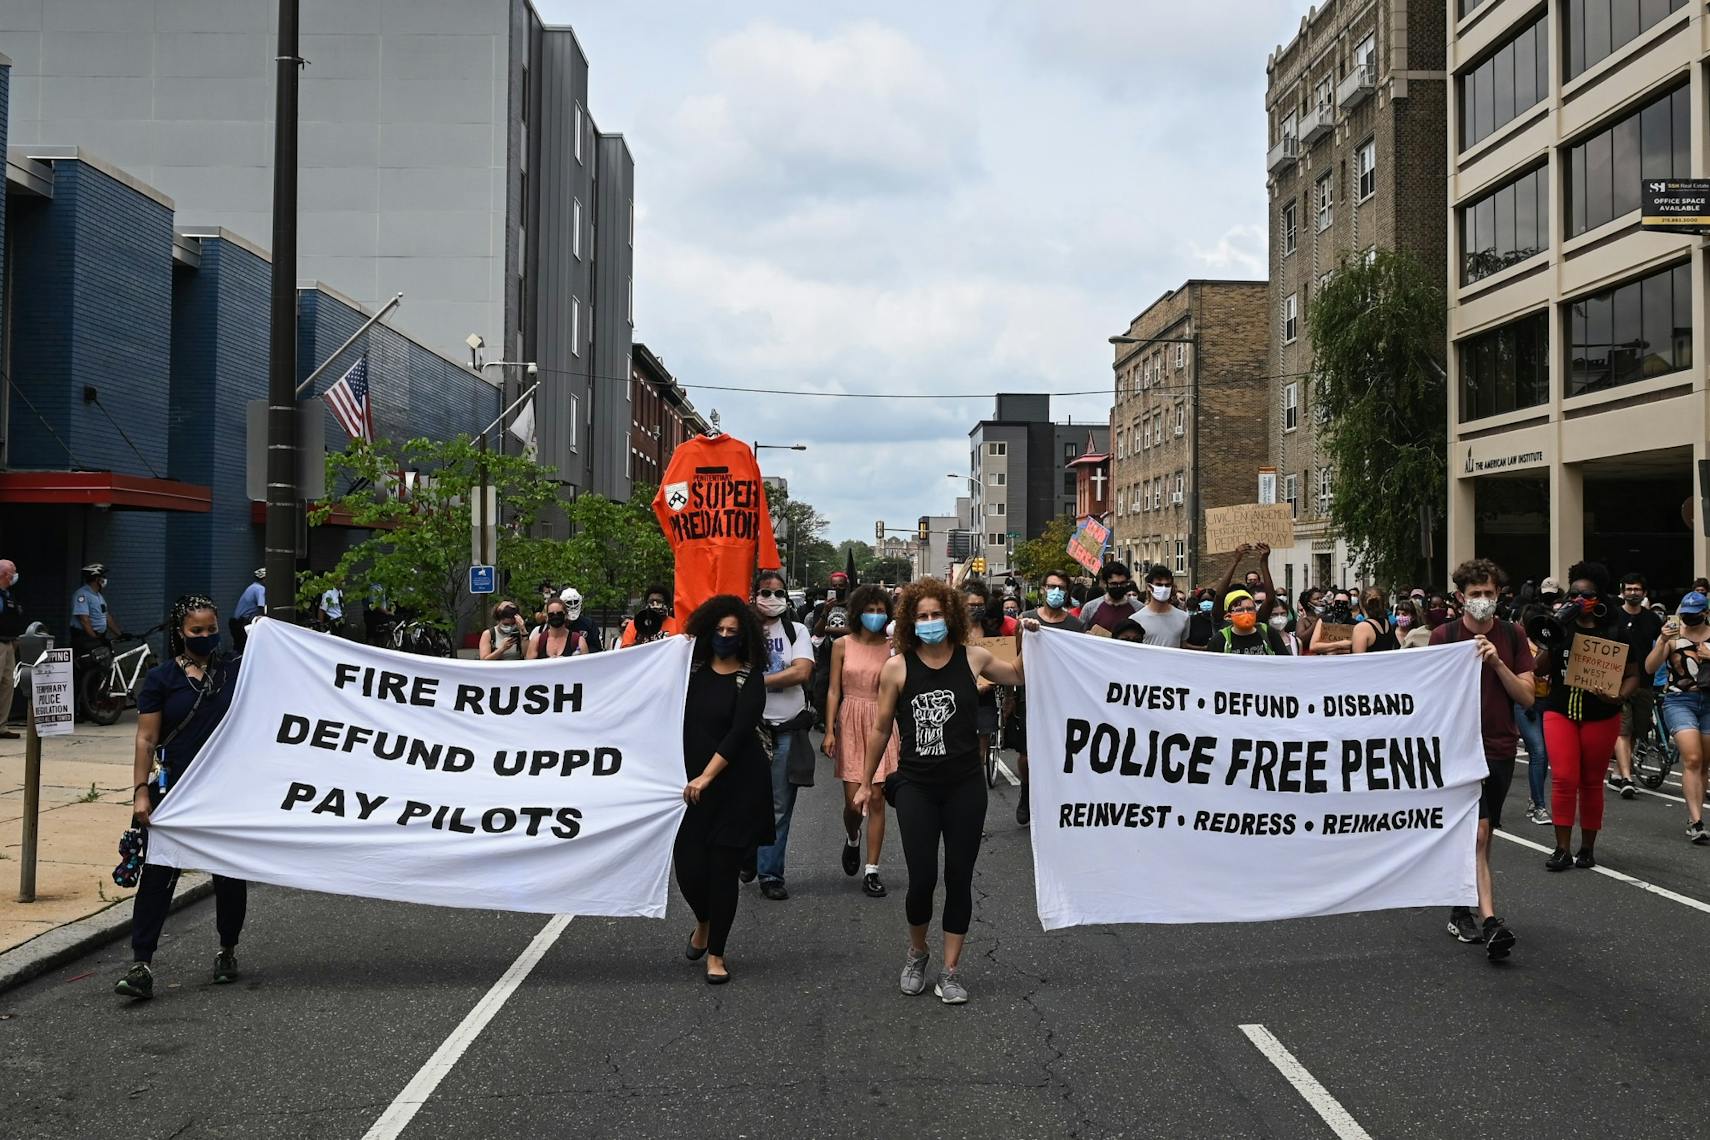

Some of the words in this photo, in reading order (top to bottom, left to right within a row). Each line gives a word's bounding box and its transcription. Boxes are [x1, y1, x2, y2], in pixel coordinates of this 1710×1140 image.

[1475, 461, 1484, 471] THE
[1484, 457, 1507, 470] AMERICAN
[1507, 455, 1517, 466] LAW
[1518, 450, 1543, 464] INSTITUTE
[692, 480, 759, 510] SUPER
[1583, 639, 1622, 658] STOP
[1573, 653, 1624, 673] TERRORIZING
[1574, 675, 1614, 691] PHILLY
[1583, 667, 1607, 680] WEST
[36, 684, 67, 694] TEMPORARY
[335, 663, 440, 708] FIRE
[454, 683, 583, 716] RUSH
[38, 694, 61, 705] POLICE
[1106, 682, 1190, 711] DIVEST
[1213, 691, 1300, 719] DEFUND
[1323, 693, 1415, 718] DISBAND
[35, 705, 68, 716] REGULATION
[915, 708, 951, 722] BLACK
[276, 713, 475, 773] DEFUND
[493, 747, 623, 777] UPPD
[1063, 718, 1218, 786] POLICE
[1224, 738, 1329, 794] FREE
[1341, 736, 1445, 793] PENN
[280, 782, 389, 820] PAY
[397, 800, 583, 840] PILOTS
[1059, 803, 1172, 829] REINVEST
[1193, 811, 1297, 836] REDRESS
[1322, 807, 1444, 836] REIMAGINE
